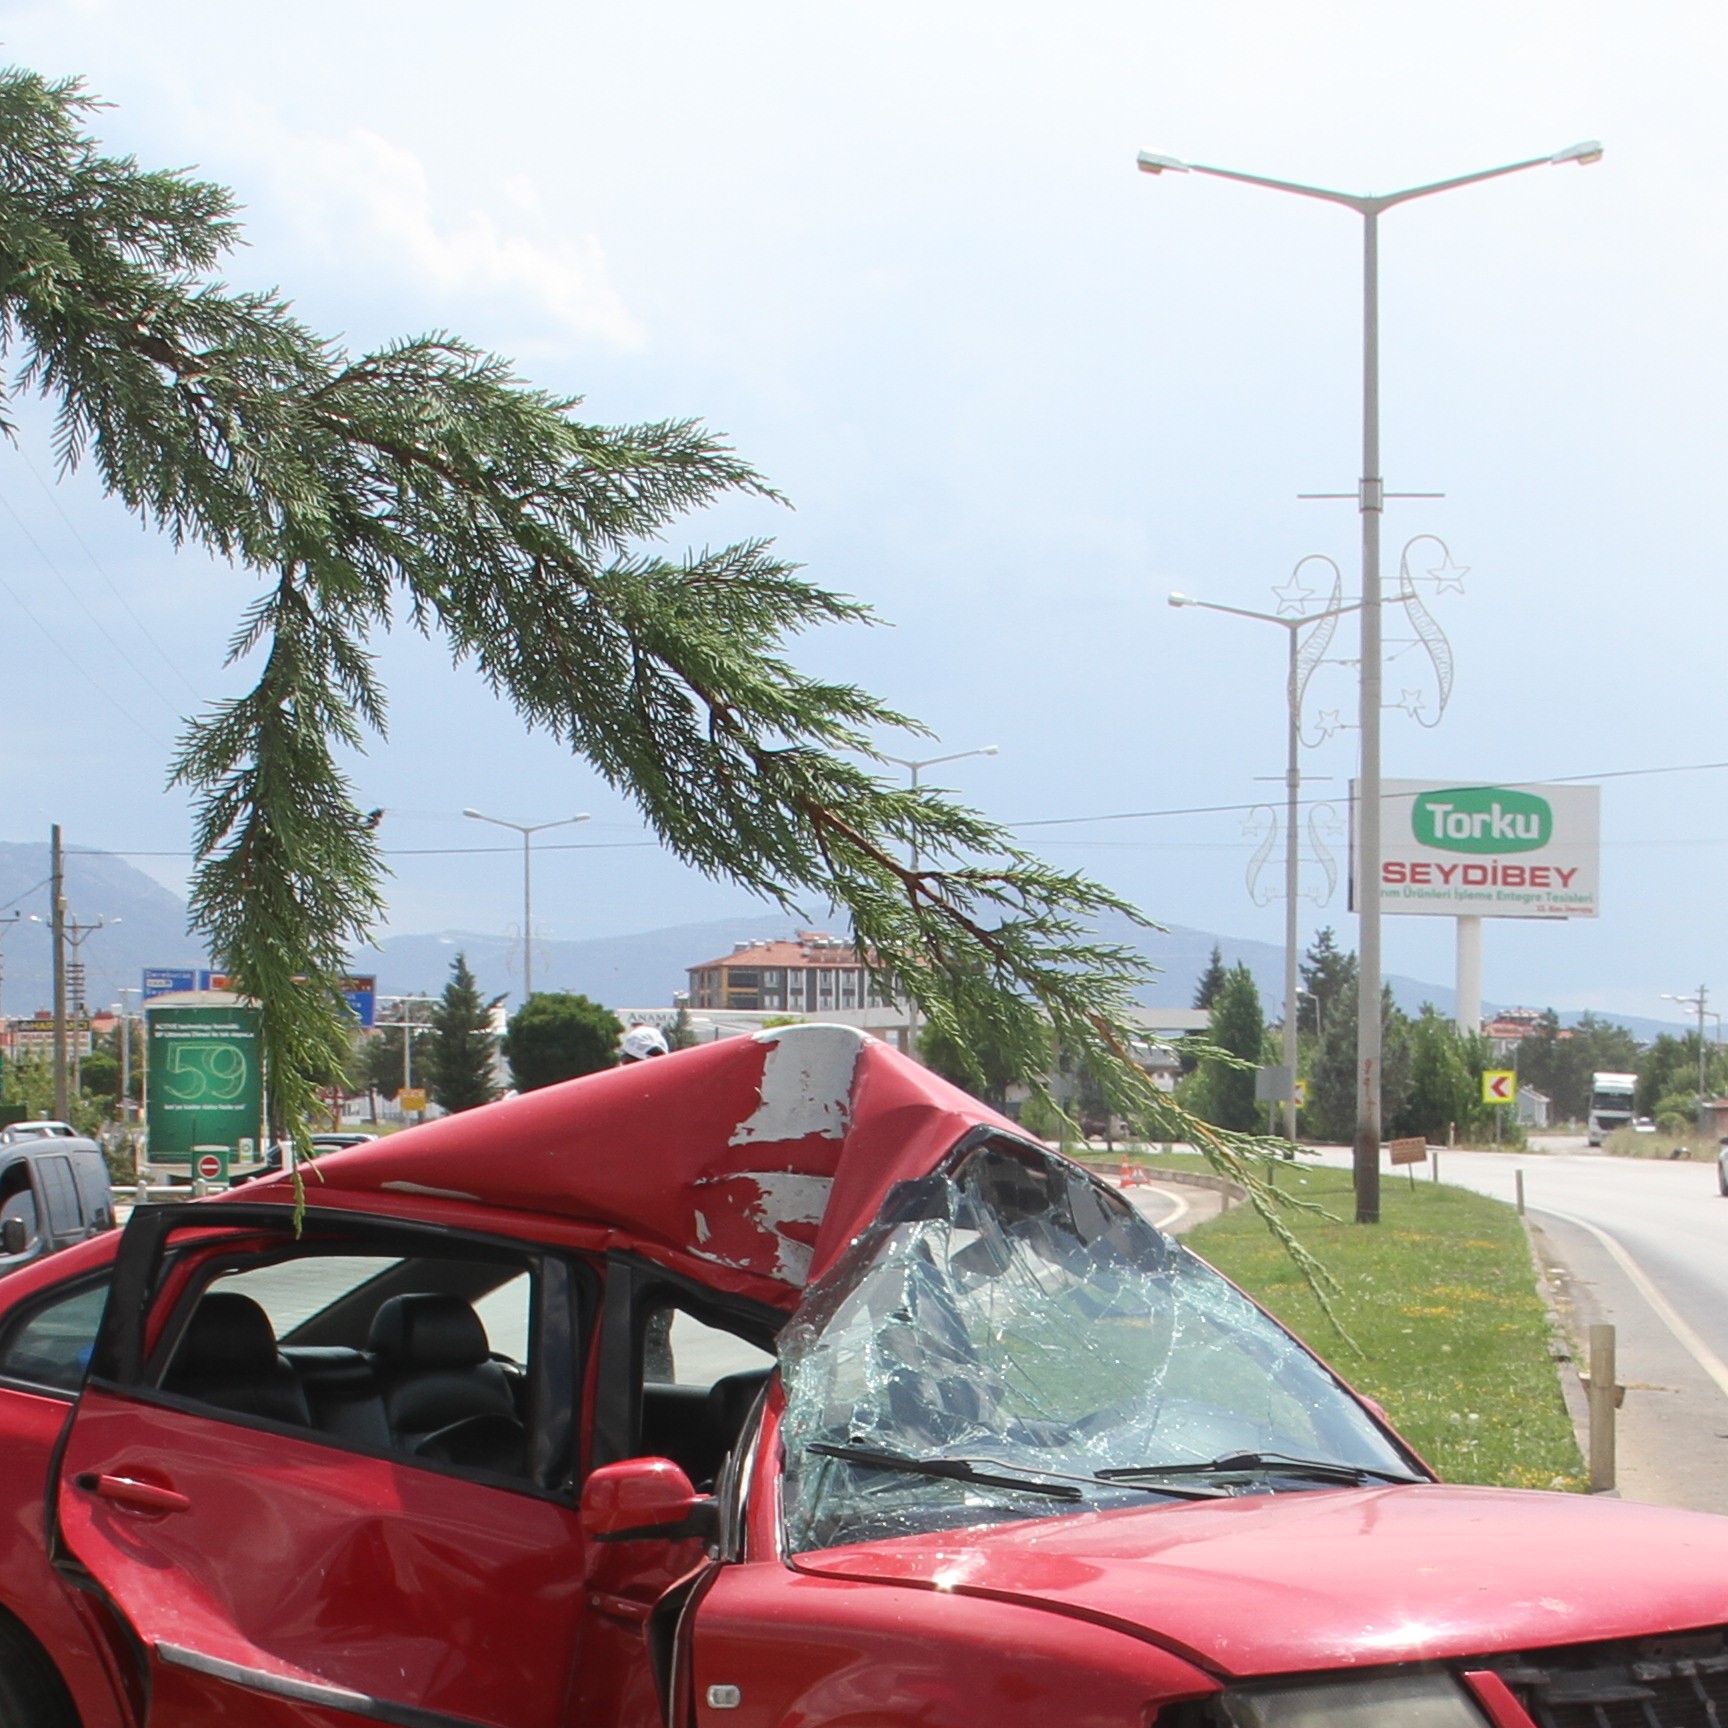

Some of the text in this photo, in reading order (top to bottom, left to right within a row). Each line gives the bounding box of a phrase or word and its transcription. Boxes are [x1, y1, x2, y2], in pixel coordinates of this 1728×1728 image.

[1425, 802, 1540, 839] Torku
[1382, 859, 1579, 888] SEYDİBEY
[628, 1013, 677, 1022] ANAMA
[163, 1041, 248, 1100] 59
